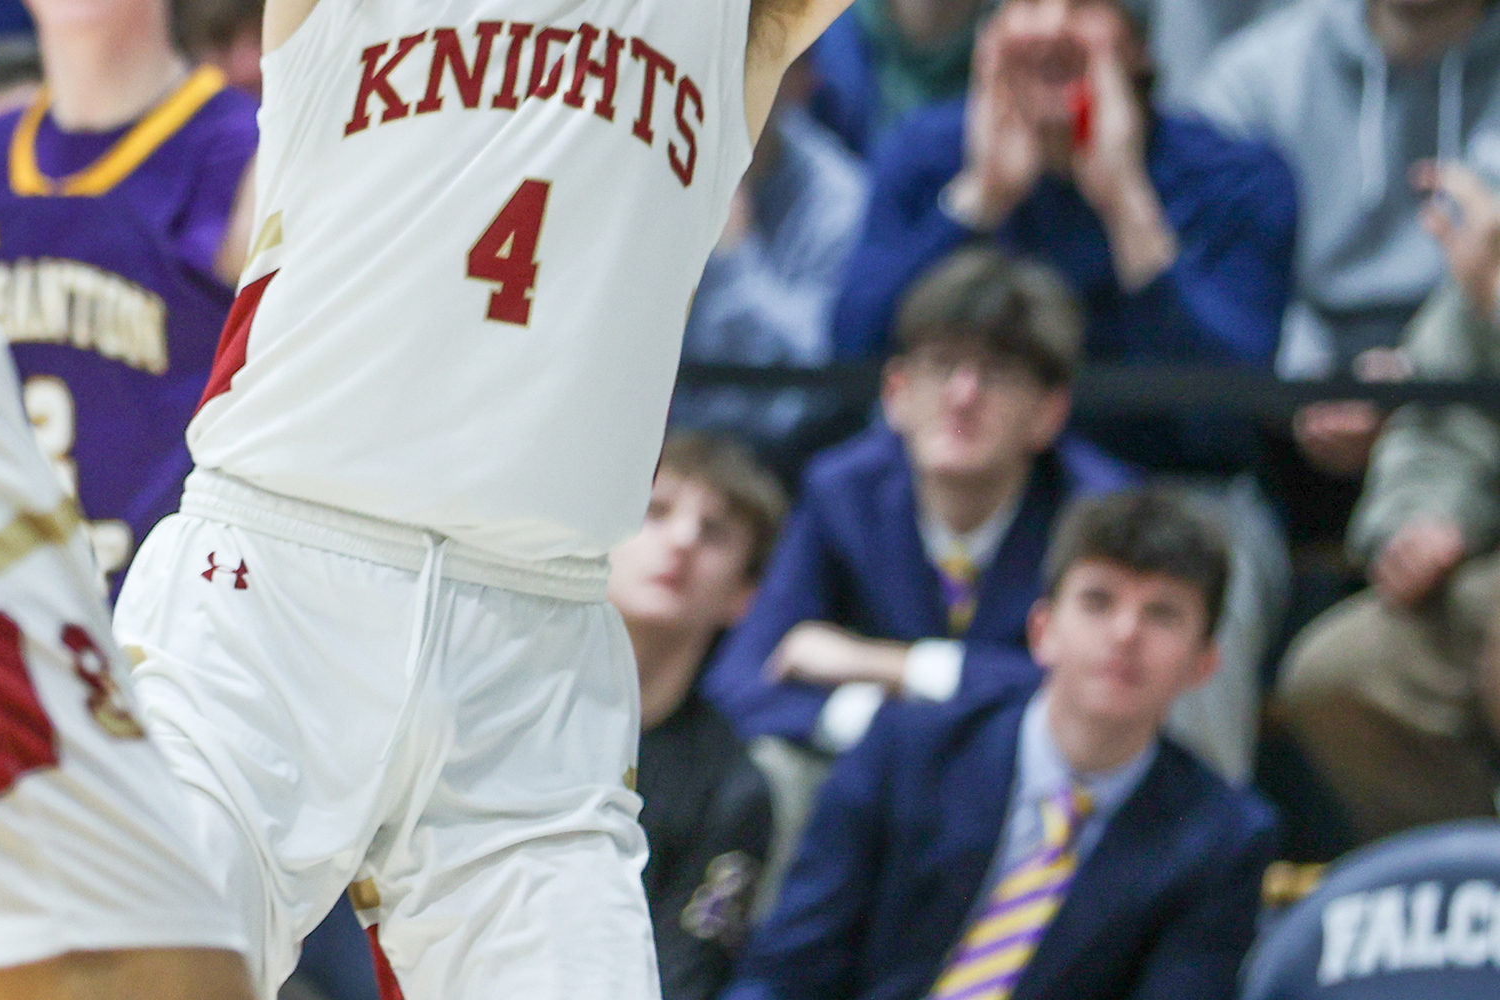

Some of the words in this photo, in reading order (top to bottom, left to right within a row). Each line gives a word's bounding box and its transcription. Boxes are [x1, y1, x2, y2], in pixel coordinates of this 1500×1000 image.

[342, 20, 705, 188] KNIGHTS
[464, 177, 553, 329] 4
[1316, 878, 1500, 988] FALC
